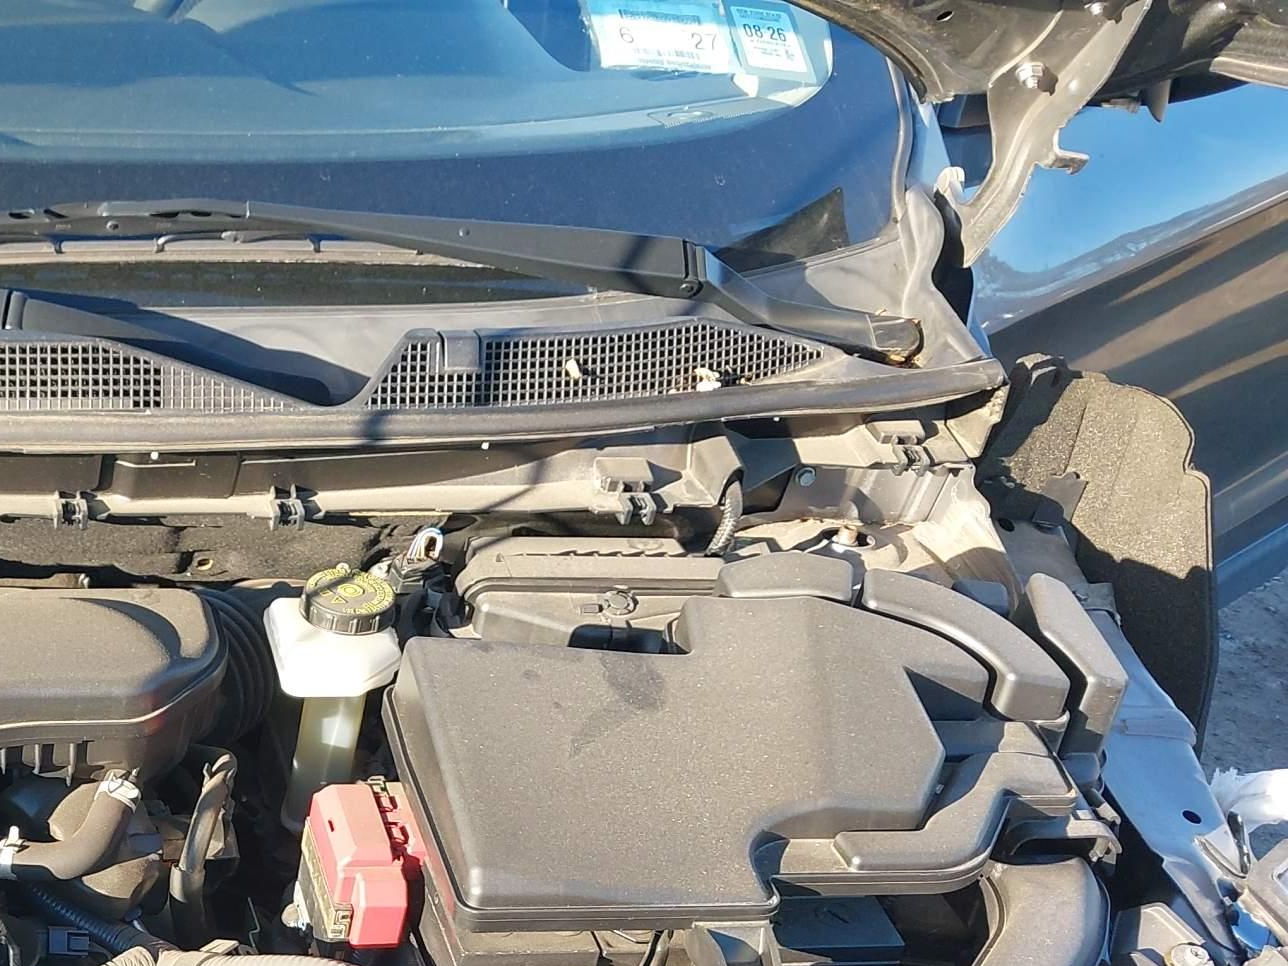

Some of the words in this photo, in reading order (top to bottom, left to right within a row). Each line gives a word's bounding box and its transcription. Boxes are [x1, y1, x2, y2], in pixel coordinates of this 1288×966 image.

[619, 25, 634, 43] 6
[690, 31, 717, 51] 27
[742, 23, 764, 39] 08
[767, 25, 787, 42] 26
